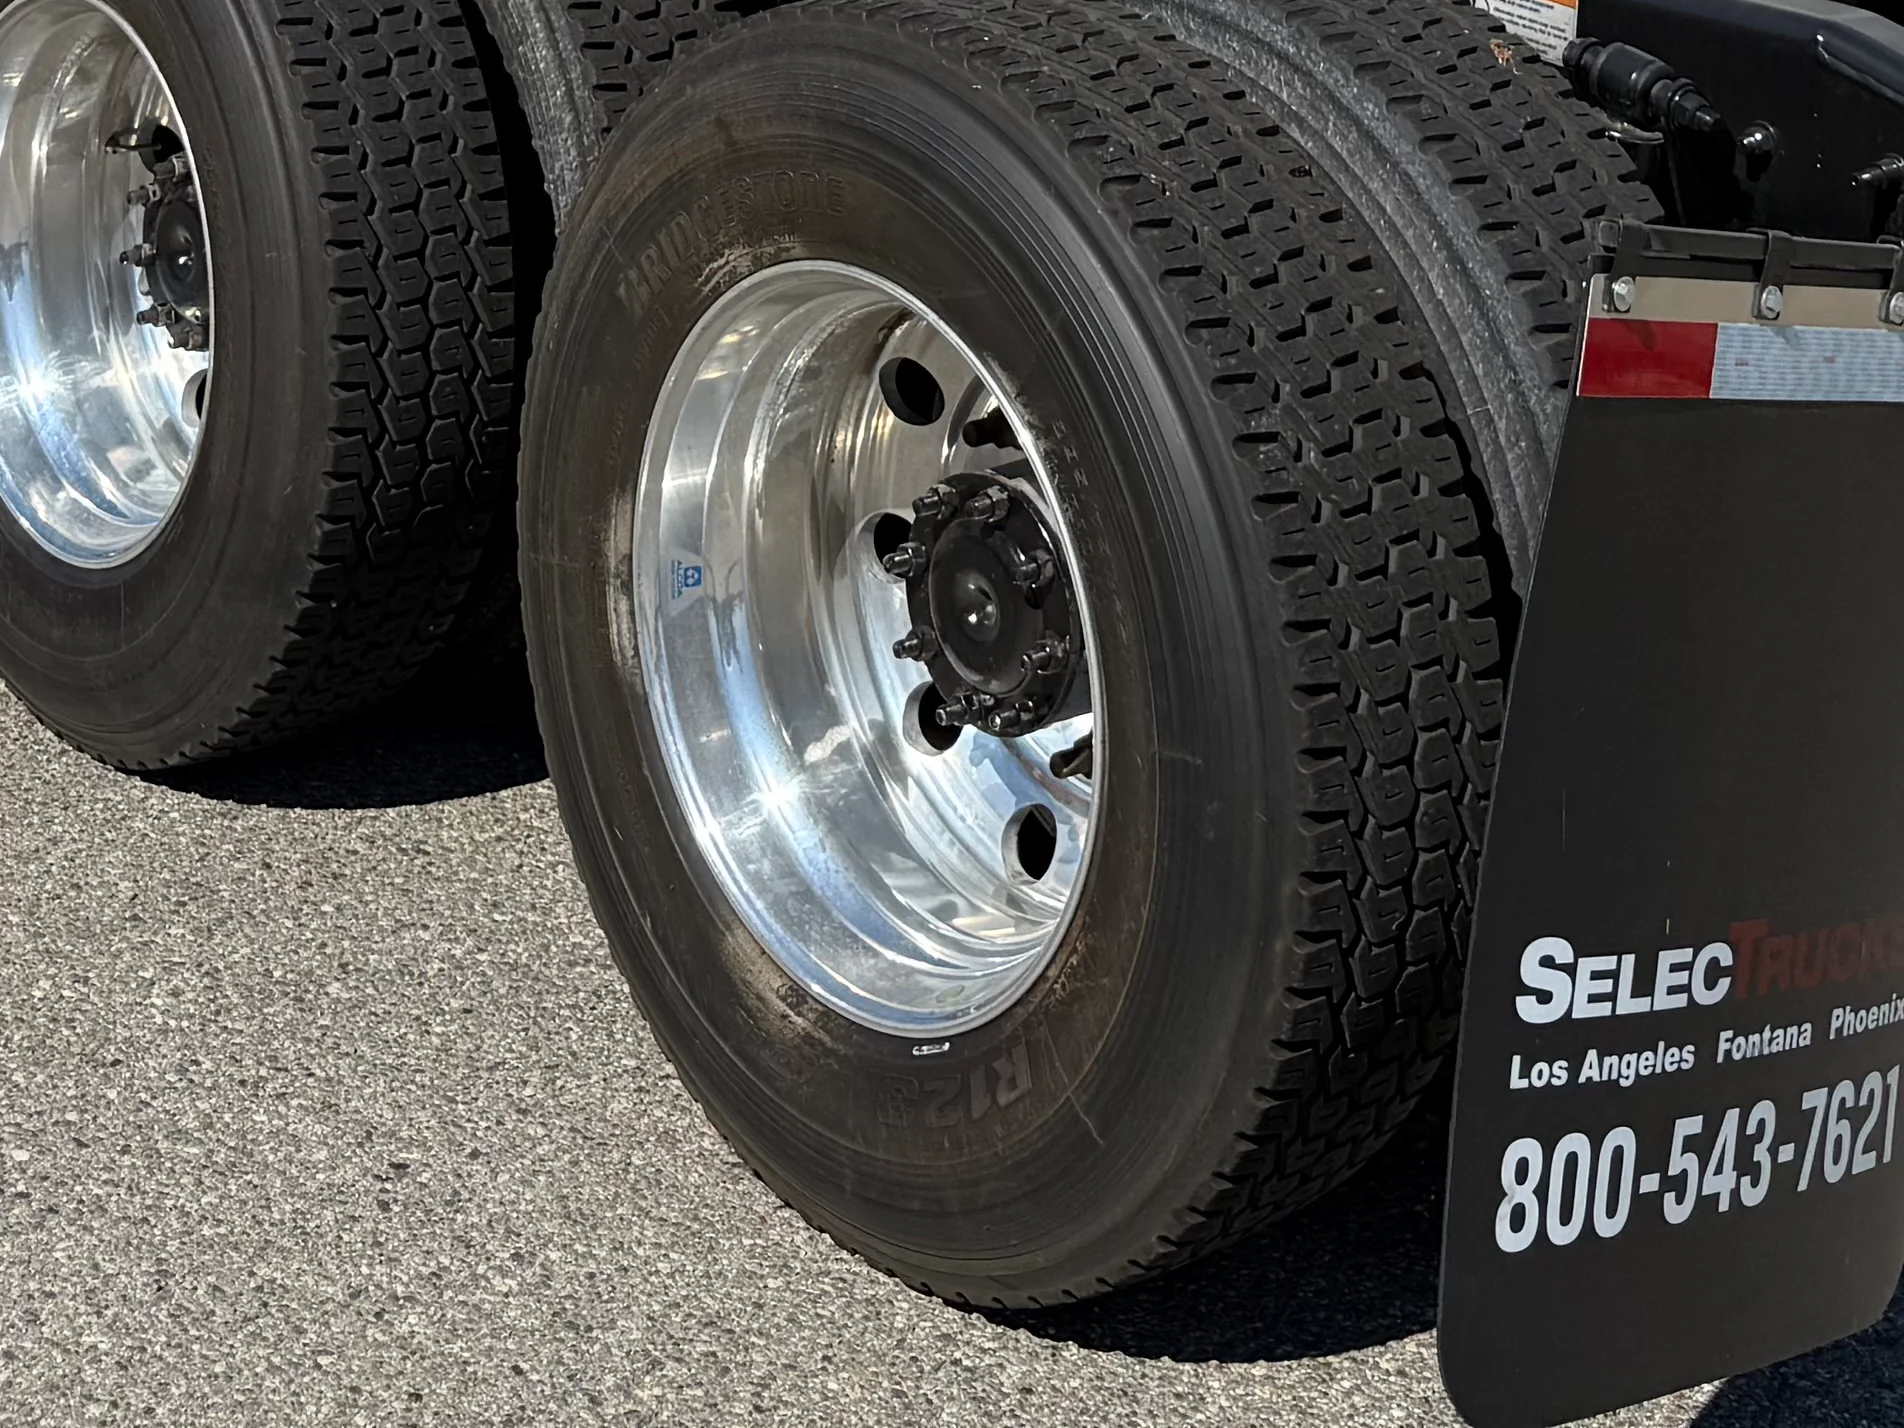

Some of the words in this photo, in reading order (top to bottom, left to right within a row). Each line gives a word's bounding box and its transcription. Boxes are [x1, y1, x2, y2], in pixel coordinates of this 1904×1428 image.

[1509, 1054, 1570, 1090] Los
[1577, 1040, 1696, 1088] Angeles
[1716, 1020, 1813, 1064] Fontana
[1495, 1064, 1901, 1254] 800-543-7621
